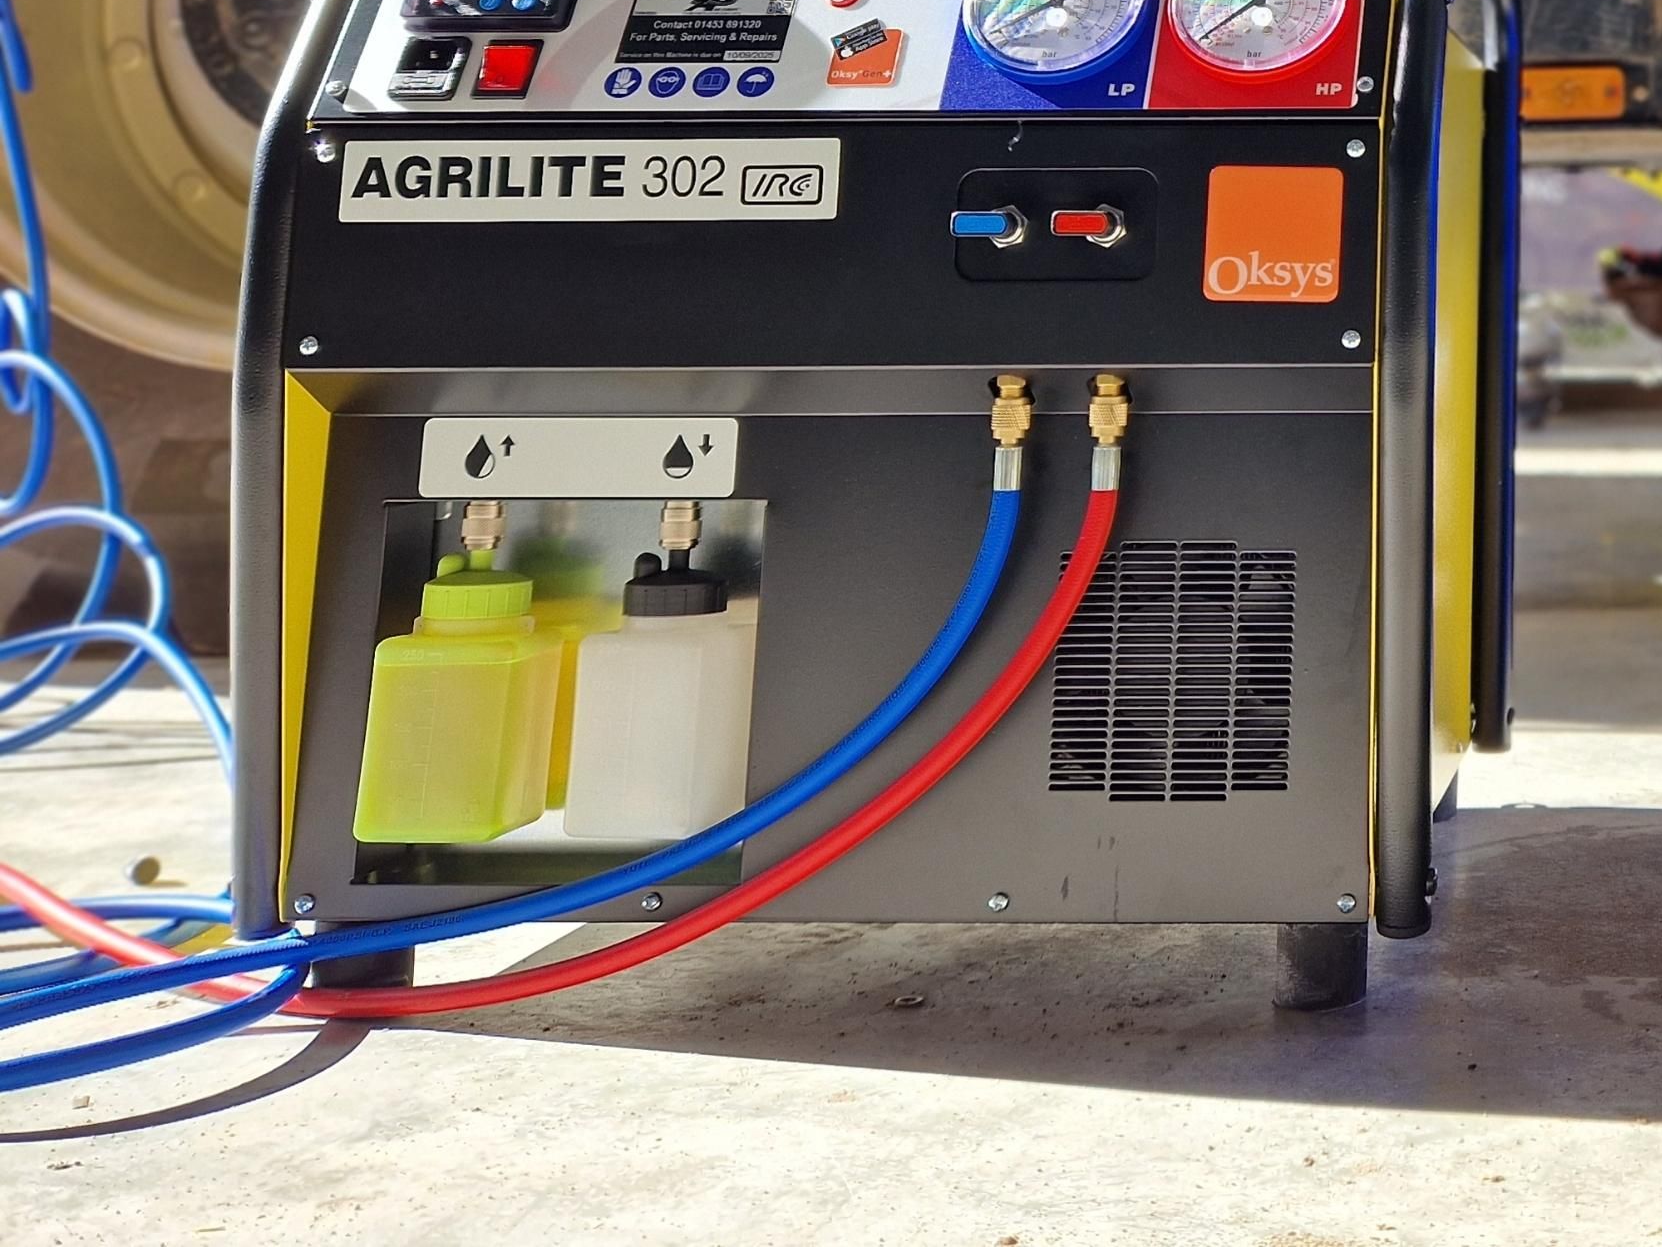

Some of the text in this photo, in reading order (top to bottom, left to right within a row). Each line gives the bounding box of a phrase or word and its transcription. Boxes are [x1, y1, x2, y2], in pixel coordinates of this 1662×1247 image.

[653, 19, 762, 29] Contact 01453 891320
[629, 32, 778, 43] For Parts, Servicing & Repairs
[1041, 50, 1057, 58] bar
[1246, 50, 1262, 58] bar
[1108, 83, 1136, 97] LP
[1315, 82, 1343, 96] HP
[351, 155, 625, 199] AGRILITE
[641, 155, 726, 198] 302
